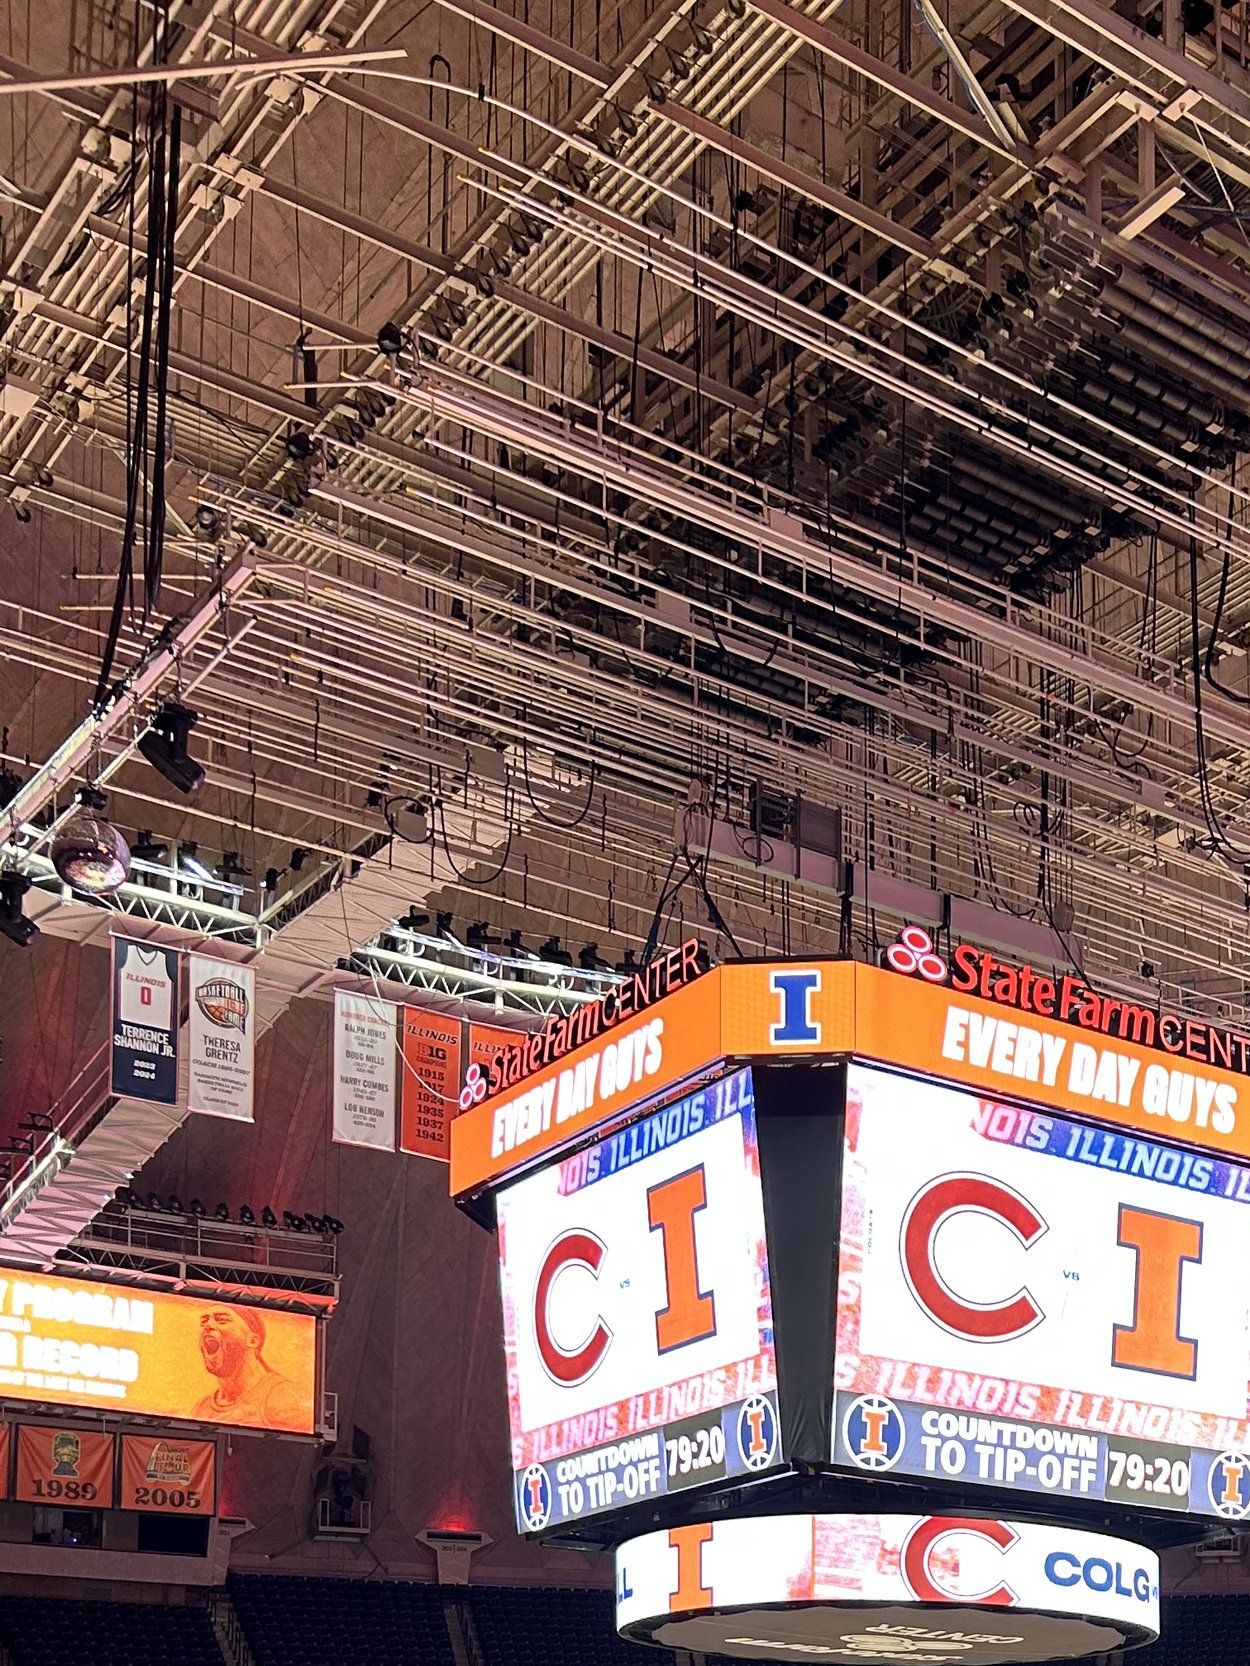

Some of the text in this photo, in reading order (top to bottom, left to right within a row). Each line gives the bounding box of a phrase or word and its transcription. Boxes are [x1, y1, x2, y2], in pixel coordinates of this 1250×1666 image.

[770, 970, 822, 1046] I
[113, 1033, 176, 1058] SHANNON JR.
[121, 1024, 170, 1046] TERRENCE
[203, 1034, 241, 1053] THERESA
[205, 1047, 239, 1064] GRENTZ
[407, 1024, 459, 1045] ILLINOIS
[417, 1067, 445, 1081] 1915
[490, 1017, 665, 1159] EVERY DAY GUYS
[941, 1004, 1239, 1135] EVERY DAY GUYS
[416, 1104, 444, 1118] 1935
[416, 1116, 444, 1131] 1937
[416, 1128, 444, 1143] 1942
[609, 1095, 706, 1172] ILLINOIS
[1065, 1126, 1214, 1190] ILLINOIS
[899, 1170, 1050, 1345] C
[1111, 1202, 1204, 1382] I
[22, 1335, 140, 1382] RECORD
[881, 1360, 1044, 1415] ILLINOIS
[531, 1409, 618, 1461] ILLINOIS
[557, 1433, 659, 1483] COUNTDOWN
[665, 1425, 726, 1477] 79:20
[921, 1409, 1099, 1460] COUNTDOWN
[32, 1478, 98, 1501] 1989
[558, 1460, 661, 1516] TO TIP-OFF
[920, 1436, 1099, 1495] TO TIP-OFF
[1108, 1450, 1190, 1496] 79:20
[134, 1486, 201, 1509] 2005
